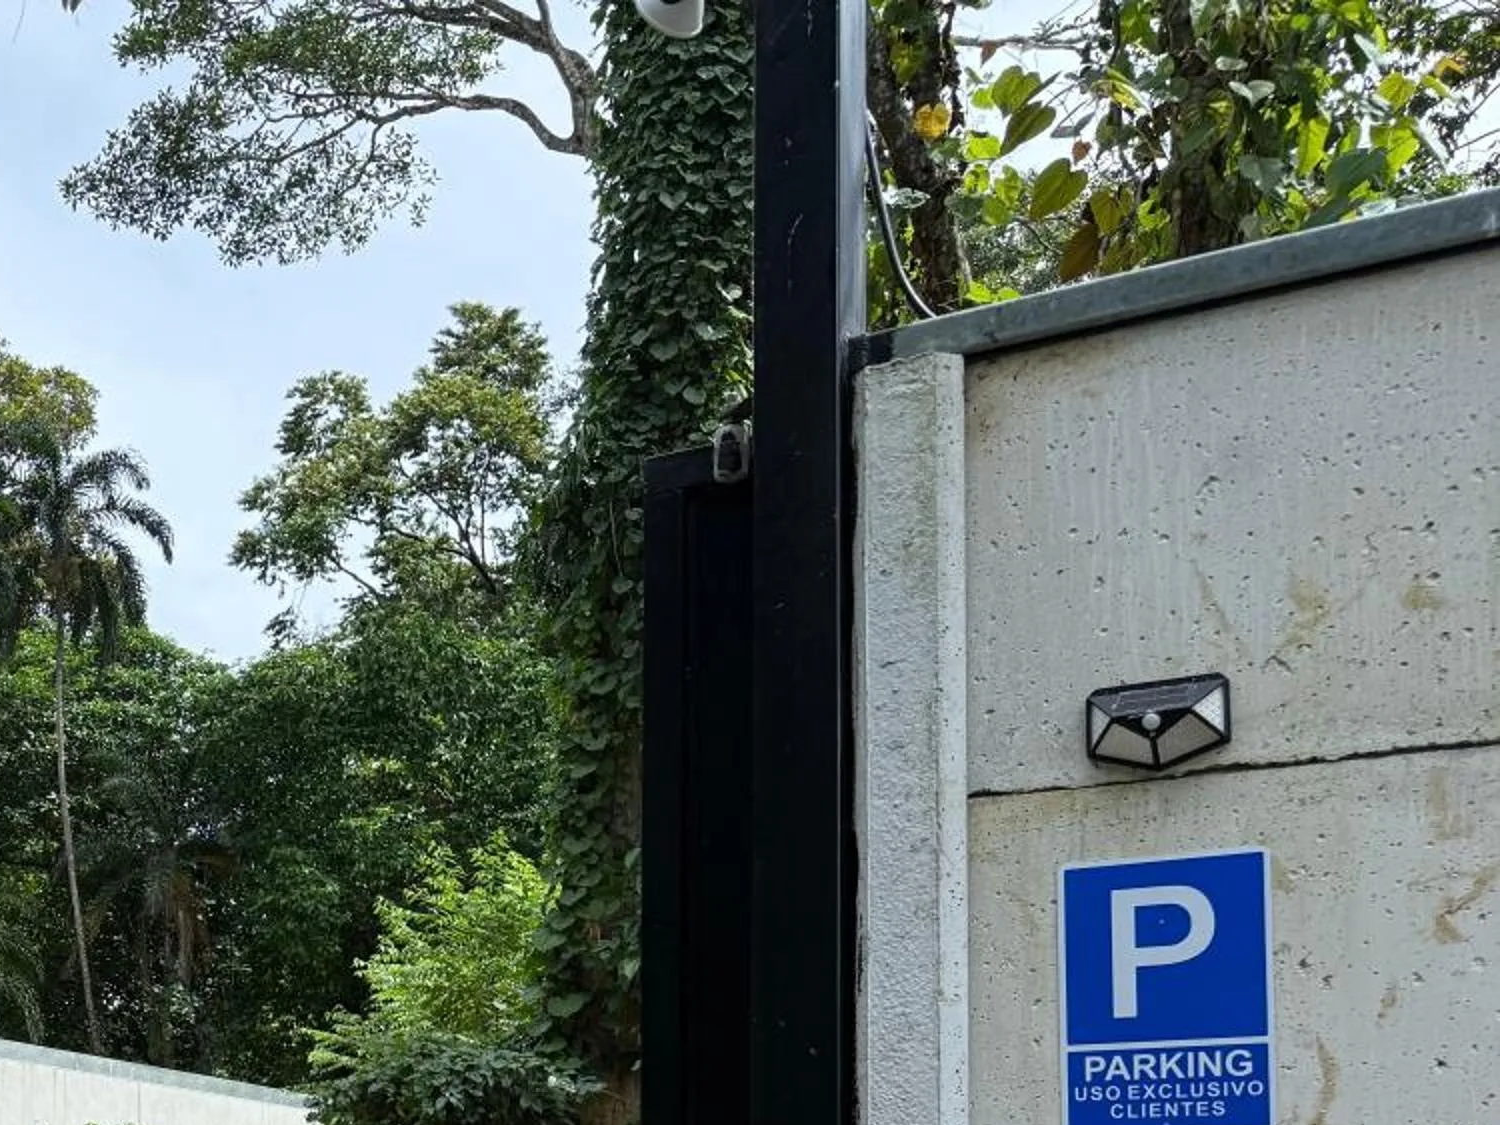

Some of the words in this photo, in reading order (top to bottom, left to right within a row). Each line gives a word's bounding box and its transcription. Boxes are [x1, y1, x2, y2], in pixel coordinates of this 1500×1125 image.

[1110, 885, 1216, 1019] P
[1085, 1049, 1253, 1082] PARKING
[1075, 1085, 1120, 1101] USO
[1128, 1081, 1263, 1100] EXCLUSIVO
[1110, 1101, 1226, 1119] CLIENTES
